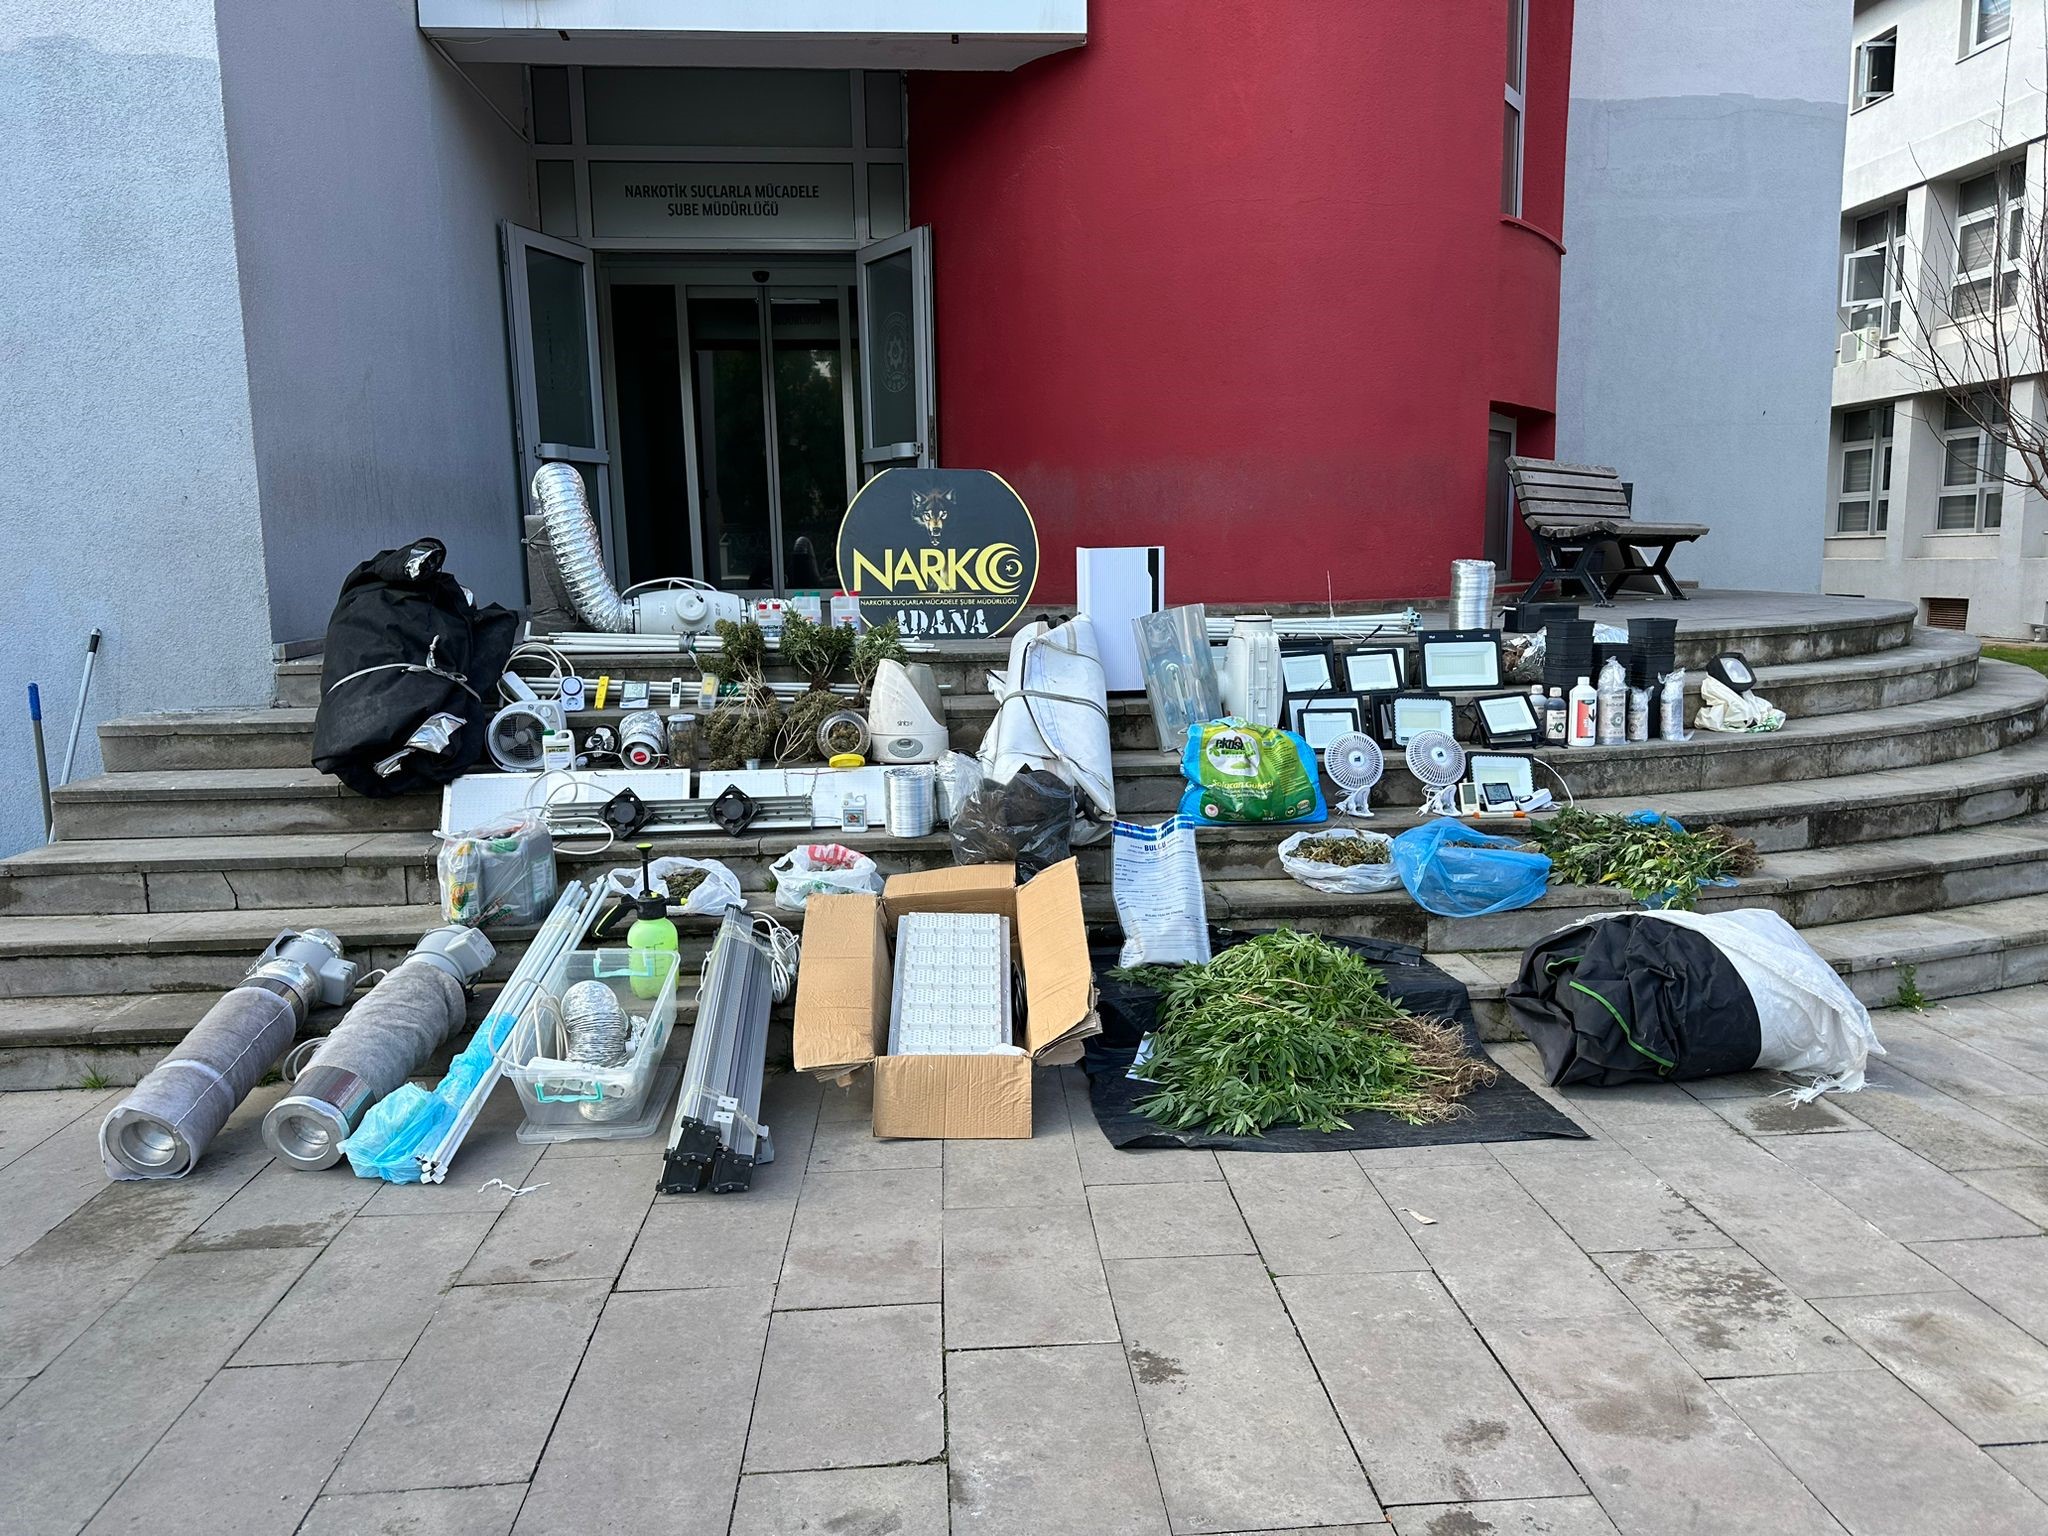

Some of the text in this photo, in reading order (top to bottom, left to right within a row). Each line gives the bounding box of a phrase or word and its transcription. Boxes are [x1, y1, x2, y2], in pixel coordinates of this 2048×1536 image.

[624, 183, 820, 200] NARKOTİK SUÇLARLA MÜCADELE
[667, 200, 779, 217] ŞUBE MÜDÜRLÜĞÜ
[960, 598, 976, 606] ŞUBE
[976, 597, 1018, 605] MÜDÜRLÜĞÜ
[896, 609, 989, 635] ADANA
